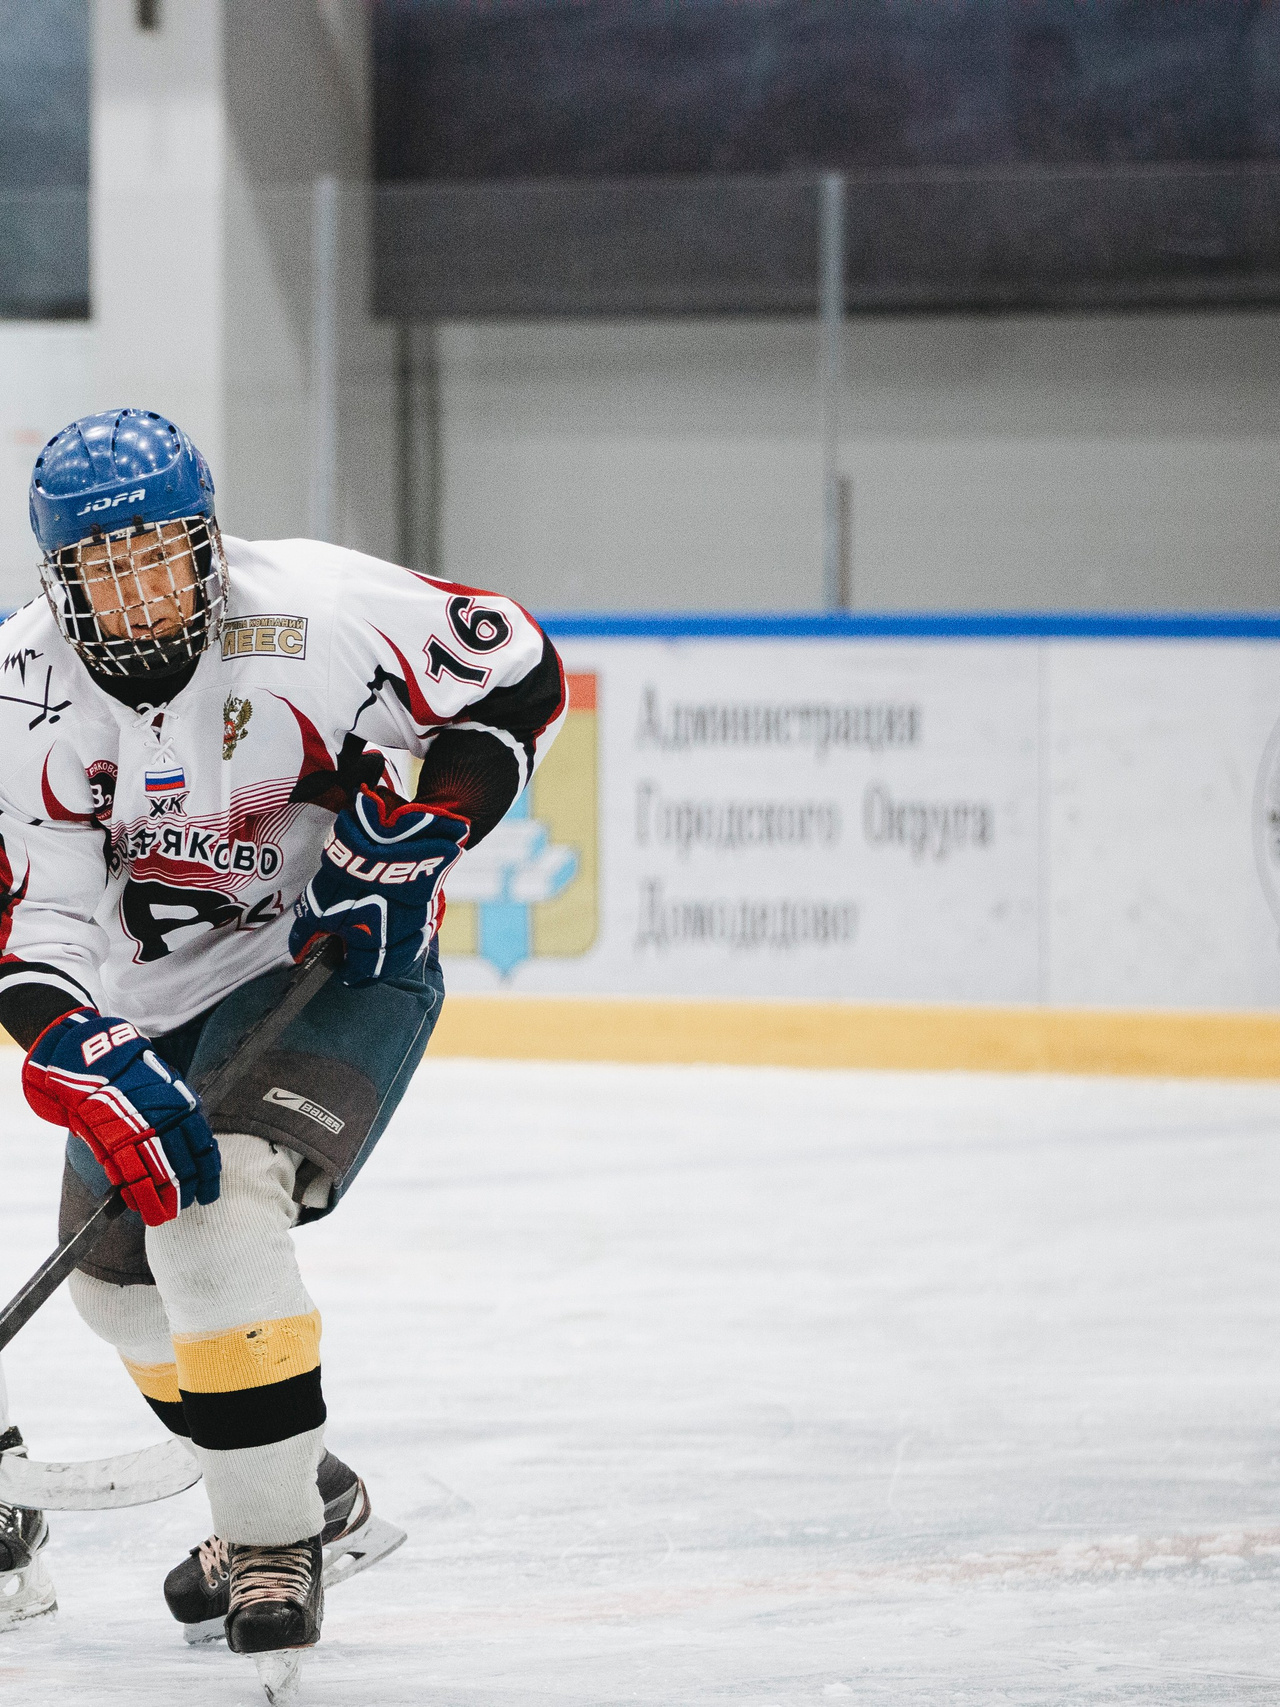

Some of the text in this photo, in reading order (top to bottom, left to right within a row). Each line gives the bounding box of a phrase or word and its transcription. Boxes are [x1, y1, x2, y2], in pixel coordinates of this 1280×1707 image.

[77, 488, 146, 516] JOFA
[249, 617, 305, 630] КОМПАНИЙ
[423, 595, 513, 689] 16
[635, 681, 924, 760] Администрация
[147, 792, 189, 819] ХК
[633, 777, 995, 864] Городского Округа
[633, 876, 862, 954] Домодедово
[300, 1103, 343, 1132] BAUER
